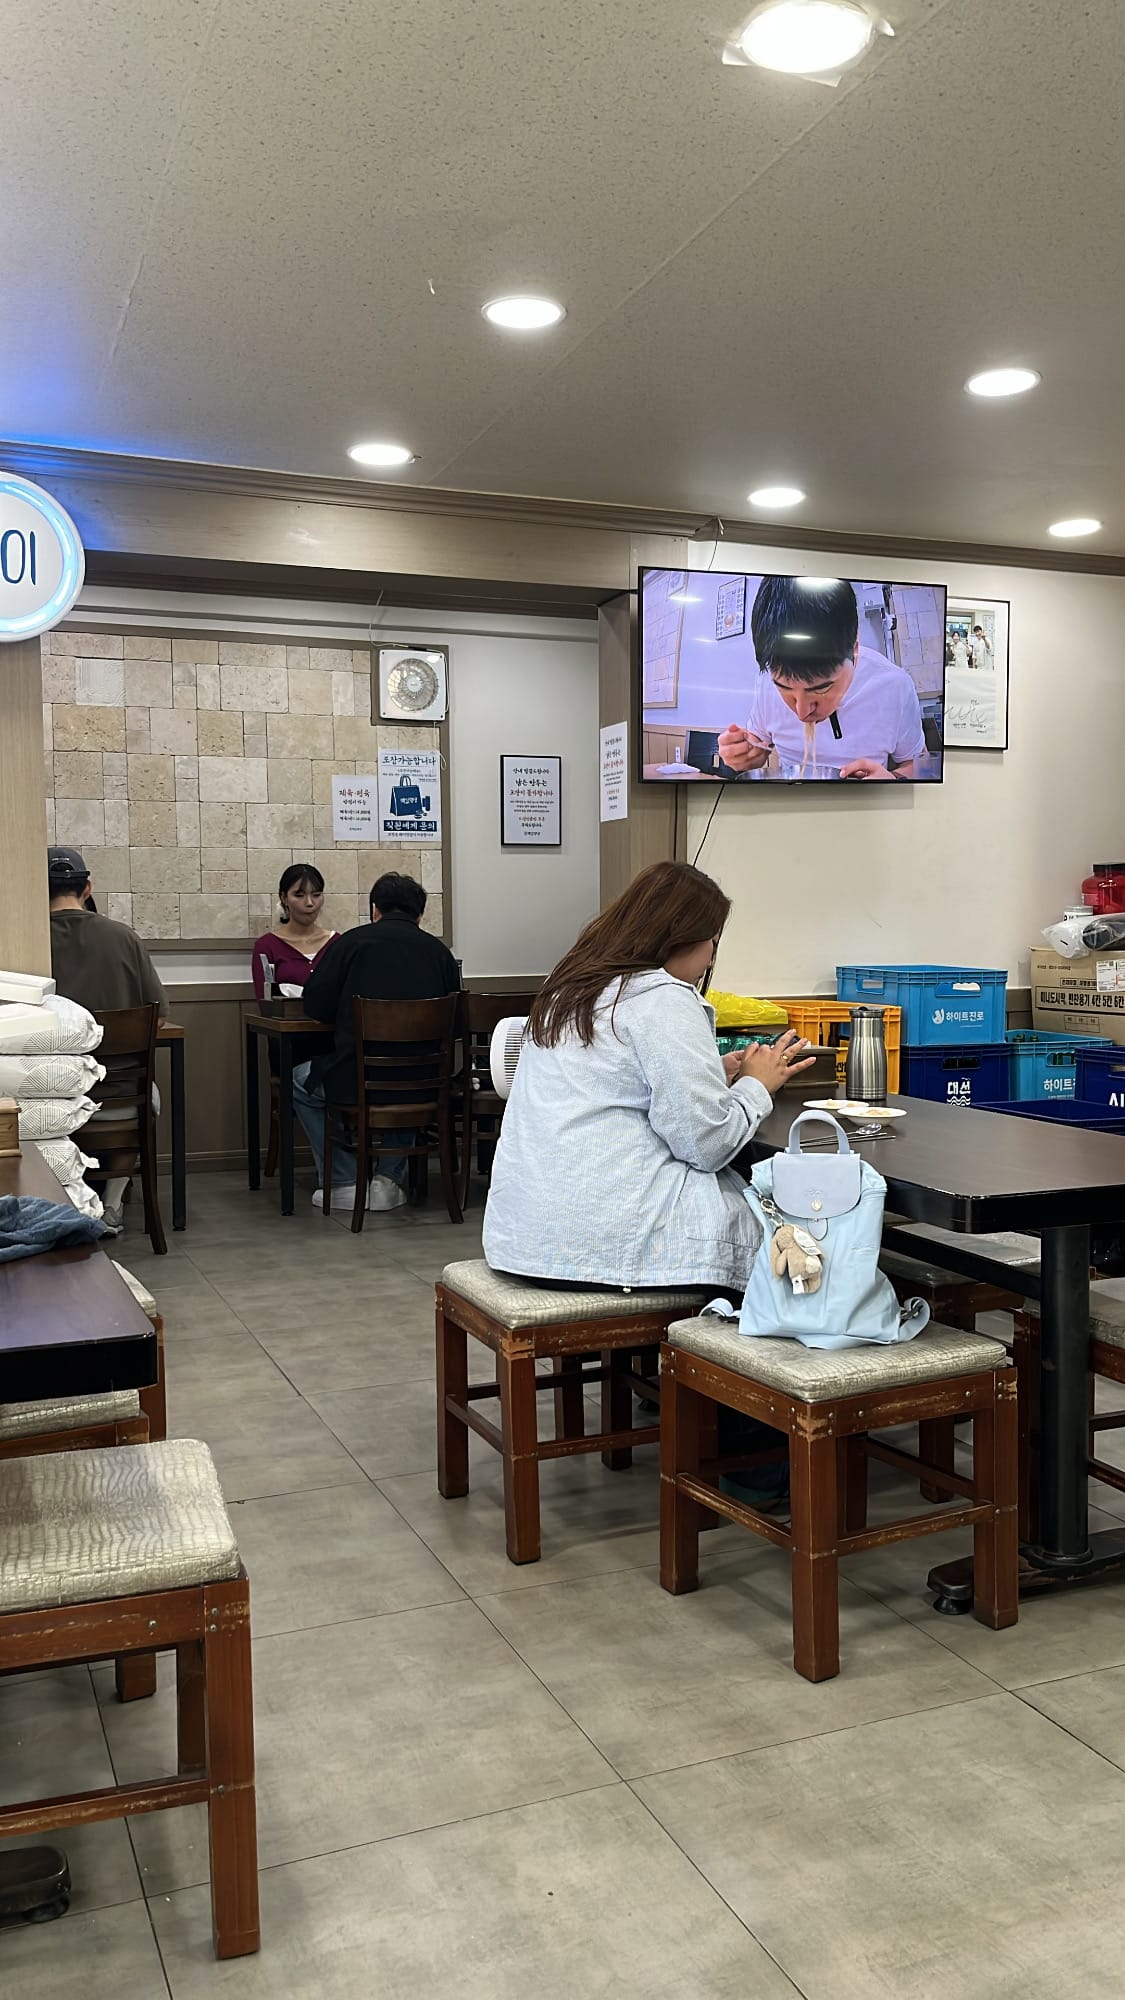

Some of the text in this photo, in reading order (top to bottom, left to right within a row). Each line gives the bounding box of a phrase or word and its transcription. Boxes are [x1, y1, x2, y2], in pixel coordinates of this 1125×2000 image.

[385, 821, 435, 831] 직원에게 문의
[1041, 991, 1066, 1005] 미니도시락
[1069, 993, 1090, 1007] 반찬용기
[946, 1011, 984, 1022] 하이트진로
[947, 1077, 971, 1095] 대선
[1043, 1078, 1076, 1092] 하이트
